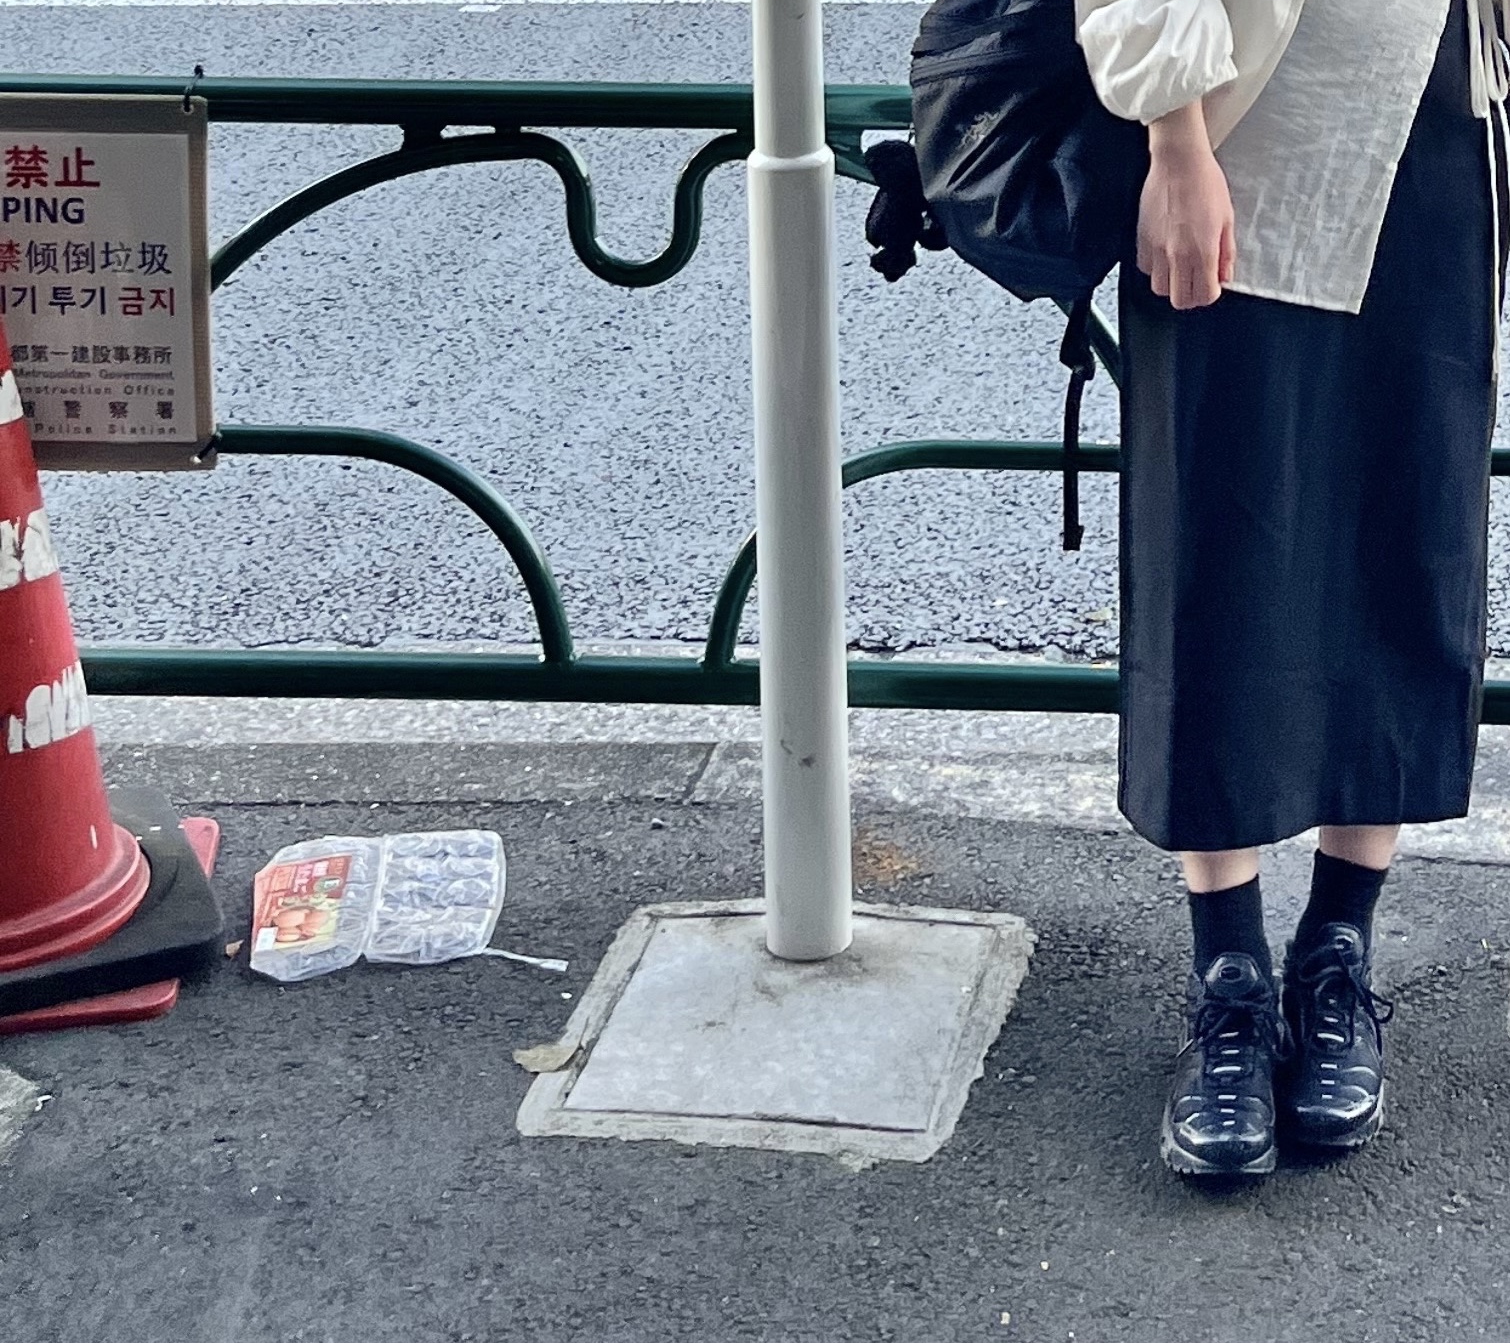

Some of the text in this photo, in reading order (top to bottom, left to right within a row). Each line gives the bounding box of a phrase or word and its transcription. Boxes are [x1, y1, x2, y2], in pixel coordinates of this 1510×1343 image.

[5, 145, 101, 189] 禁止
[2, 196, 85, 224] PING
[48, 285, 106, 315] 투기
[118, 286, 176, 316] 금지
[99, 368, 175, 381] Government
[123, 384, 175, 396] Office
[35, 423, 177, 435] Police Station
